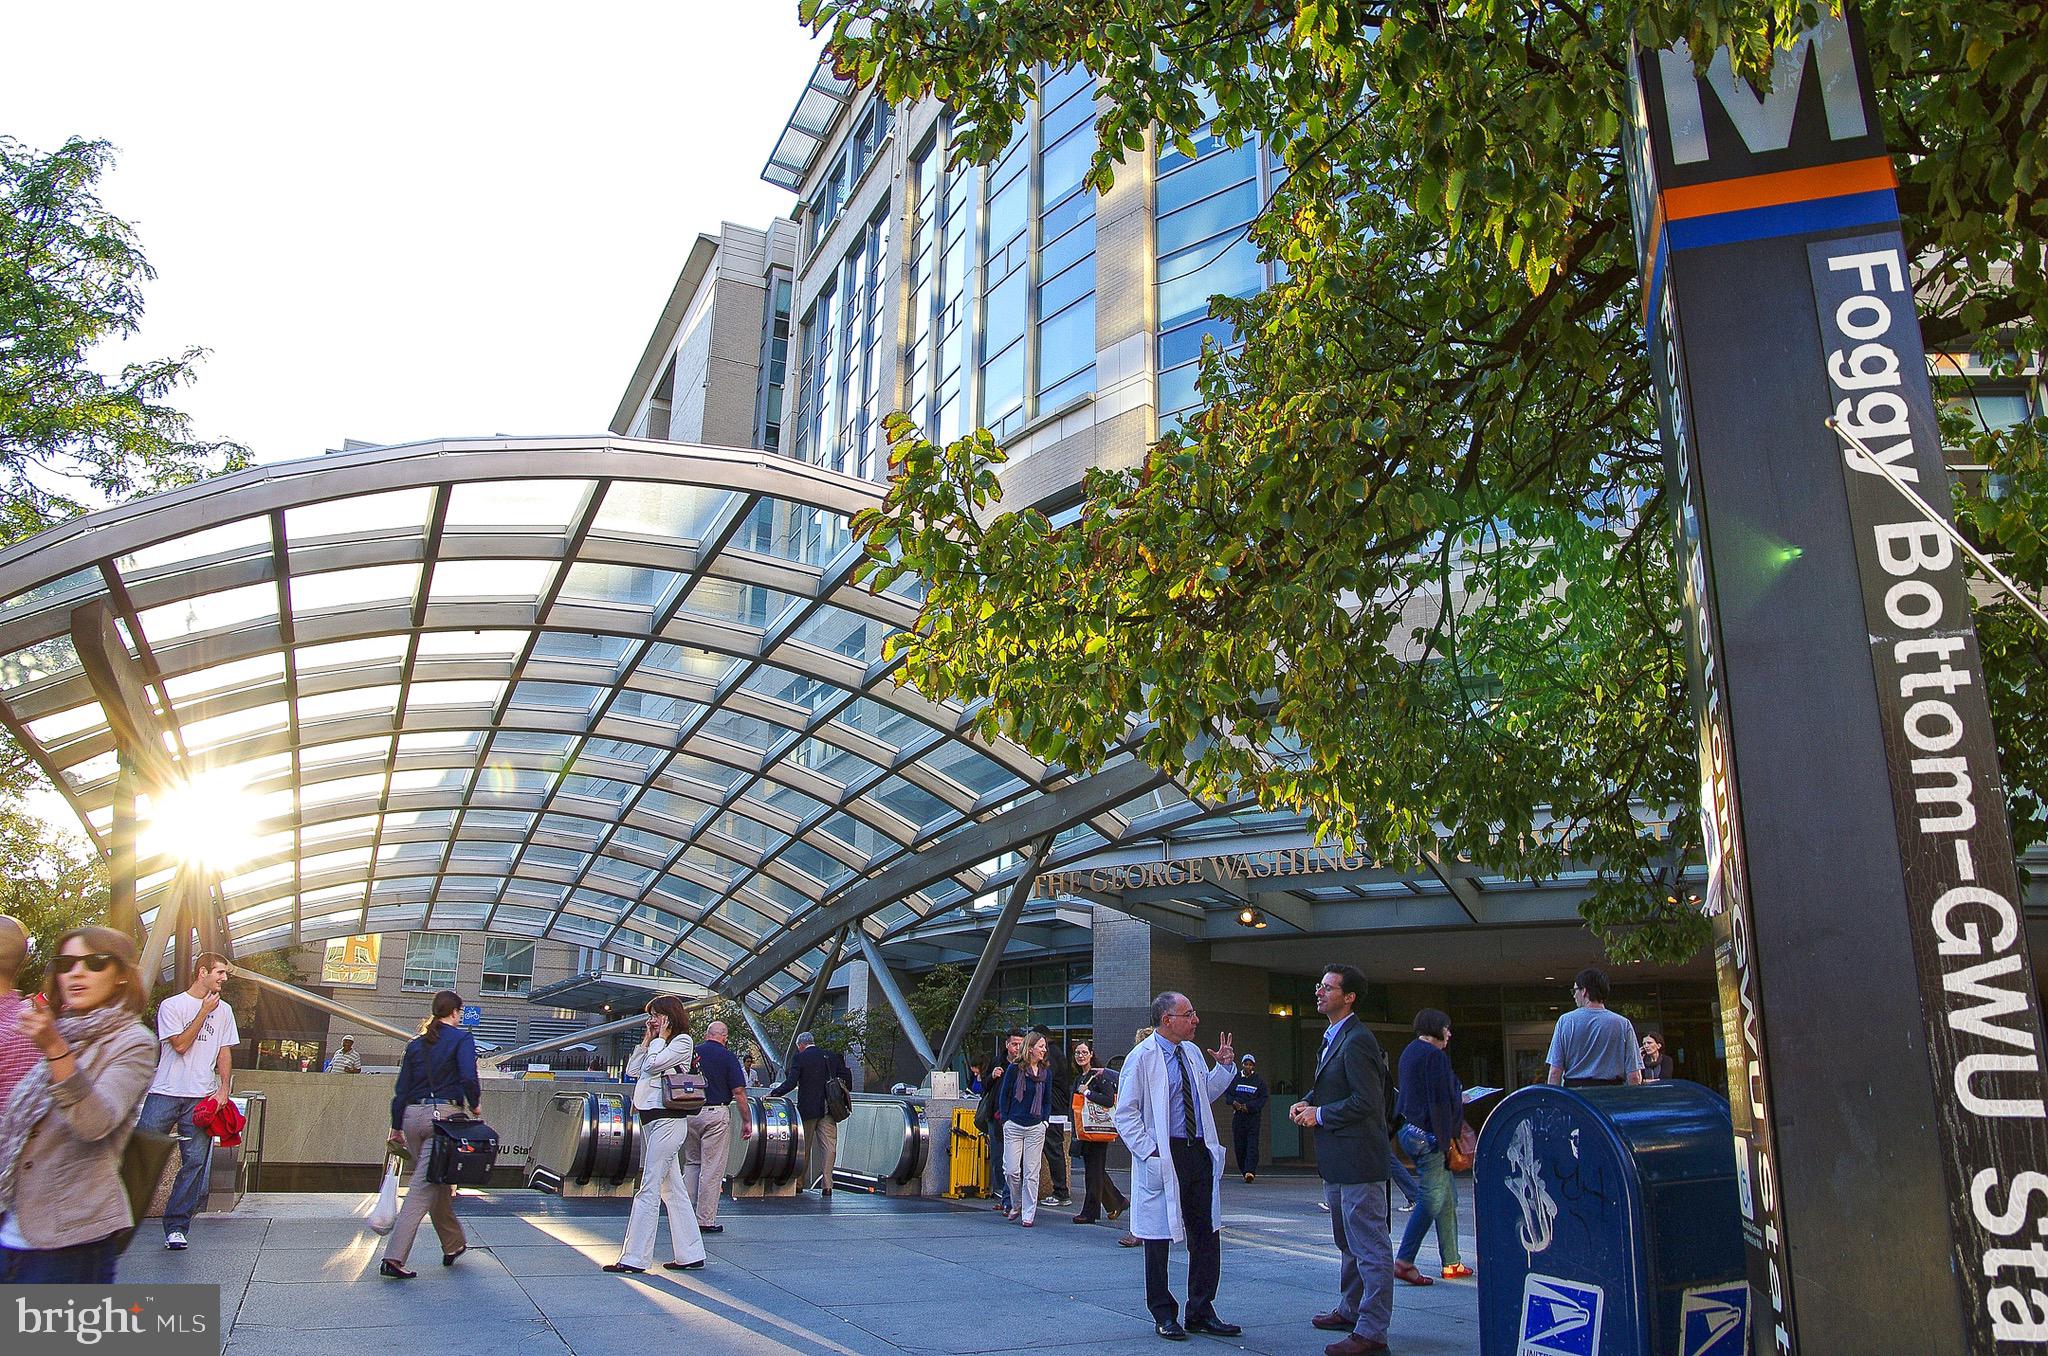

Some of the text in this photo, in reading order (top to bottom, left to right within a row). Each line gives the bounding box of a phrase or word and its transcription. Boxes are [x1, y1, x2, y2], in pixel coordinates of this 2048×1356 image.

[1657, 3, 1868, 165] M
[1827, 248, 2048, 1341] Foggy Bottom-GWU Sta
[1034, 870, 1083, 899] THE
[1089, 858, 1204, 893] GEORGE
[781, 1131, 787, 1140] 3
